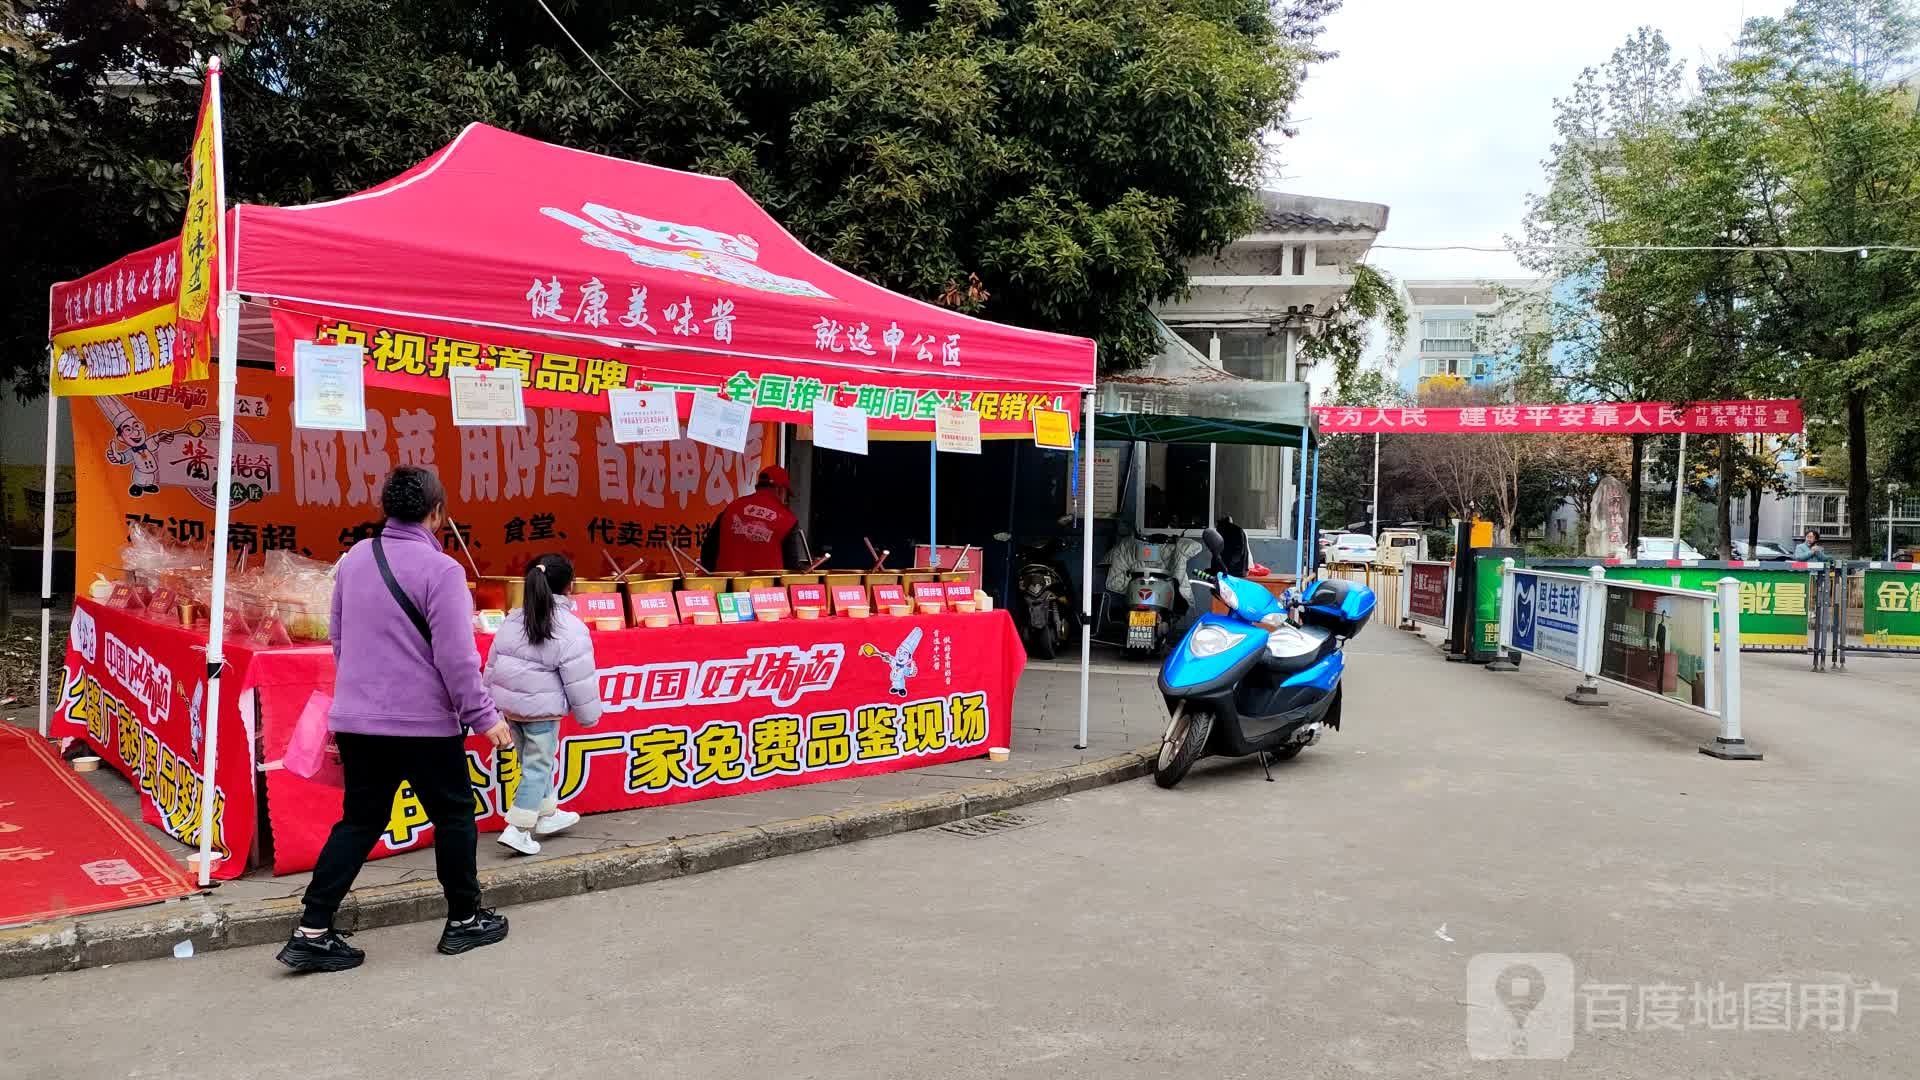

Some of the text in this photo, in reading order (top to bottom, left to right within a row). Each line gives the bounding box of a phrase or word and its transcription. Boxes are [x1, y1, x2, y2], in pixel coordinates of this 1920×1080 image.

[526, 276, 737, 345] 健康美味酱
[811, 316, 962, 368] 就选申公匠
[1458, 405, 1687, 428] 建设平安靠人民
[1773, 408, 1790, 424] 宣
[598, 647, 839, 706] 中国好味道
